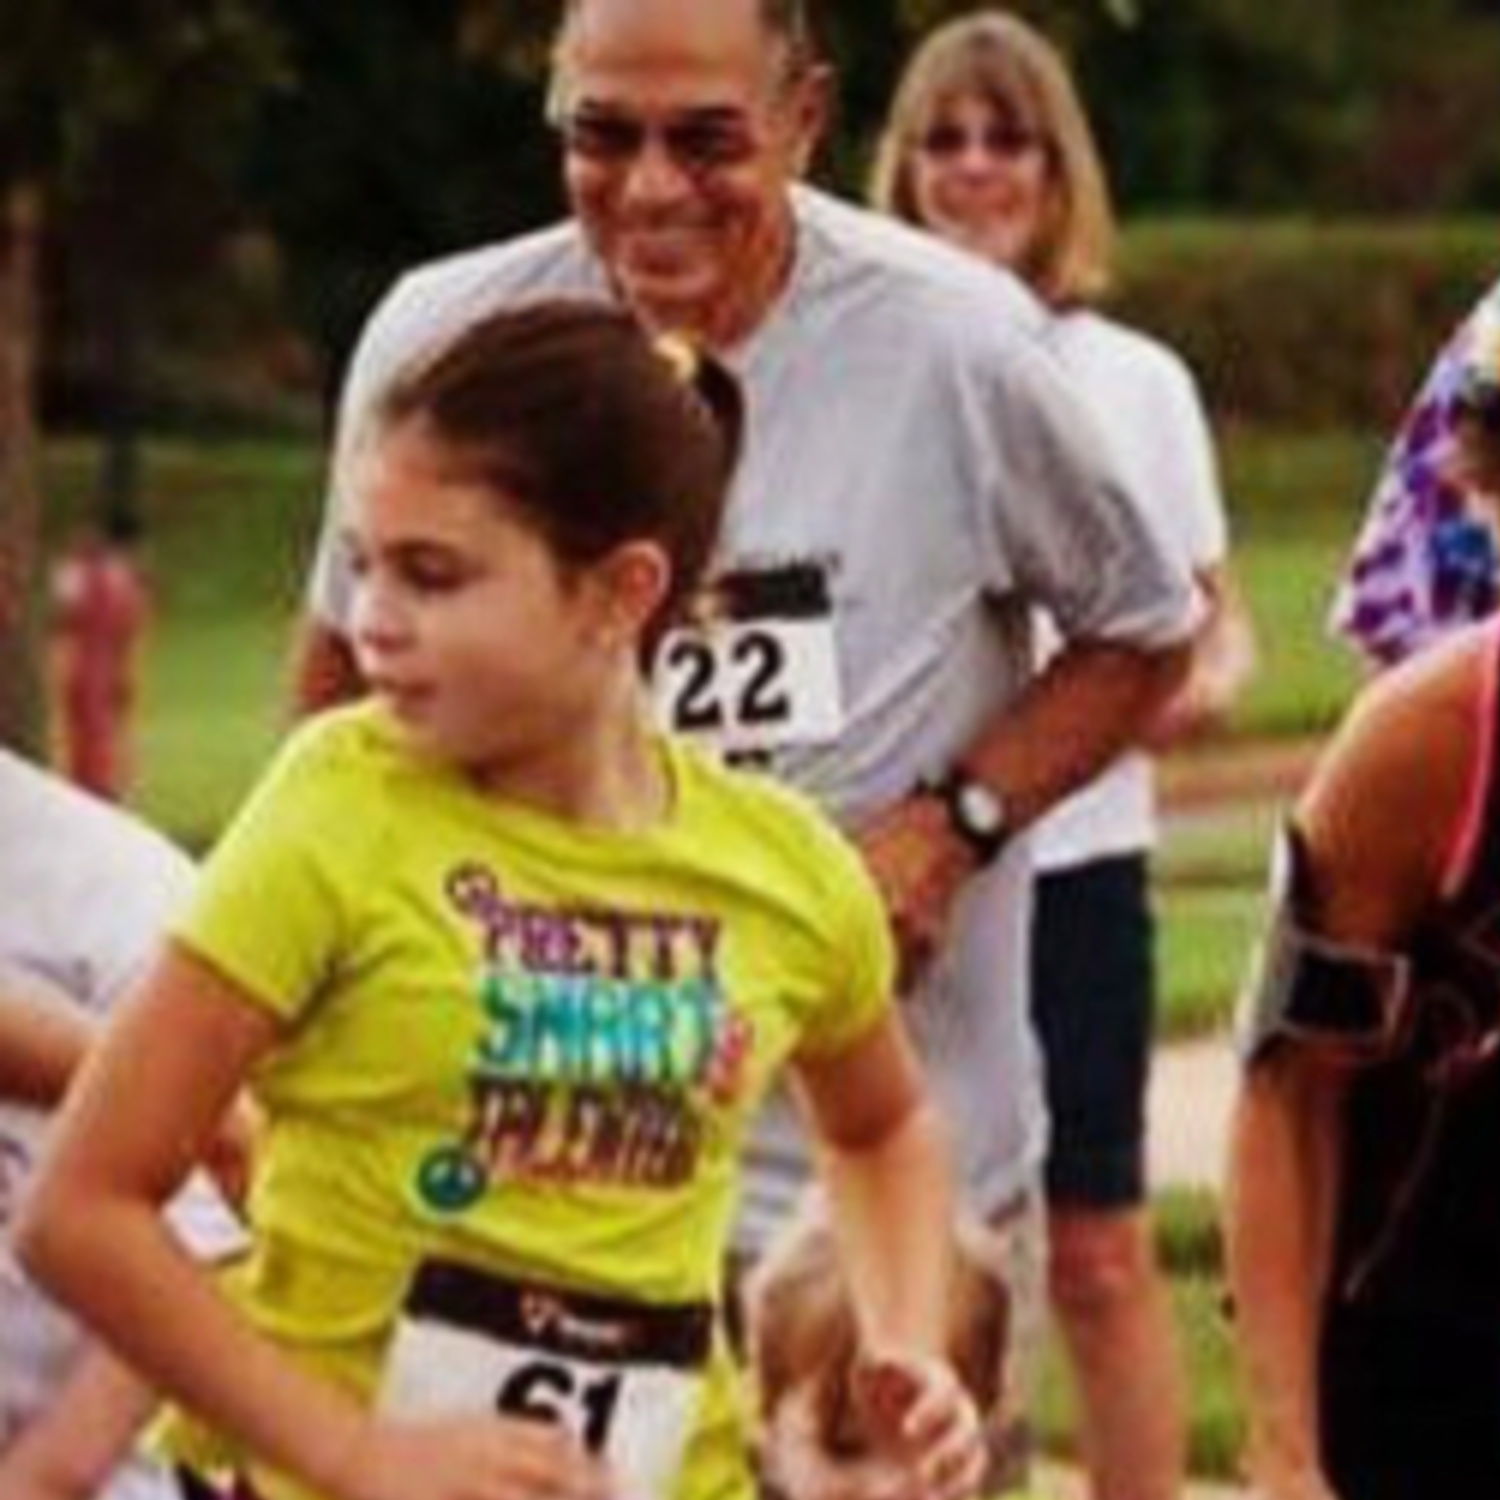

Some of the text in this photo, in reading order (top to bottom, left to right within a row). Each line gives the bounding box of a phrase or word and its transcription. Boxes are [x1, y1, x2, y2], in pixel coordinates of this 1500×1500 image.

[668, 629, 790, 734] 22
[476, 972, 724, 1084] SMART
[496, 1358, 625, 1456] 61
